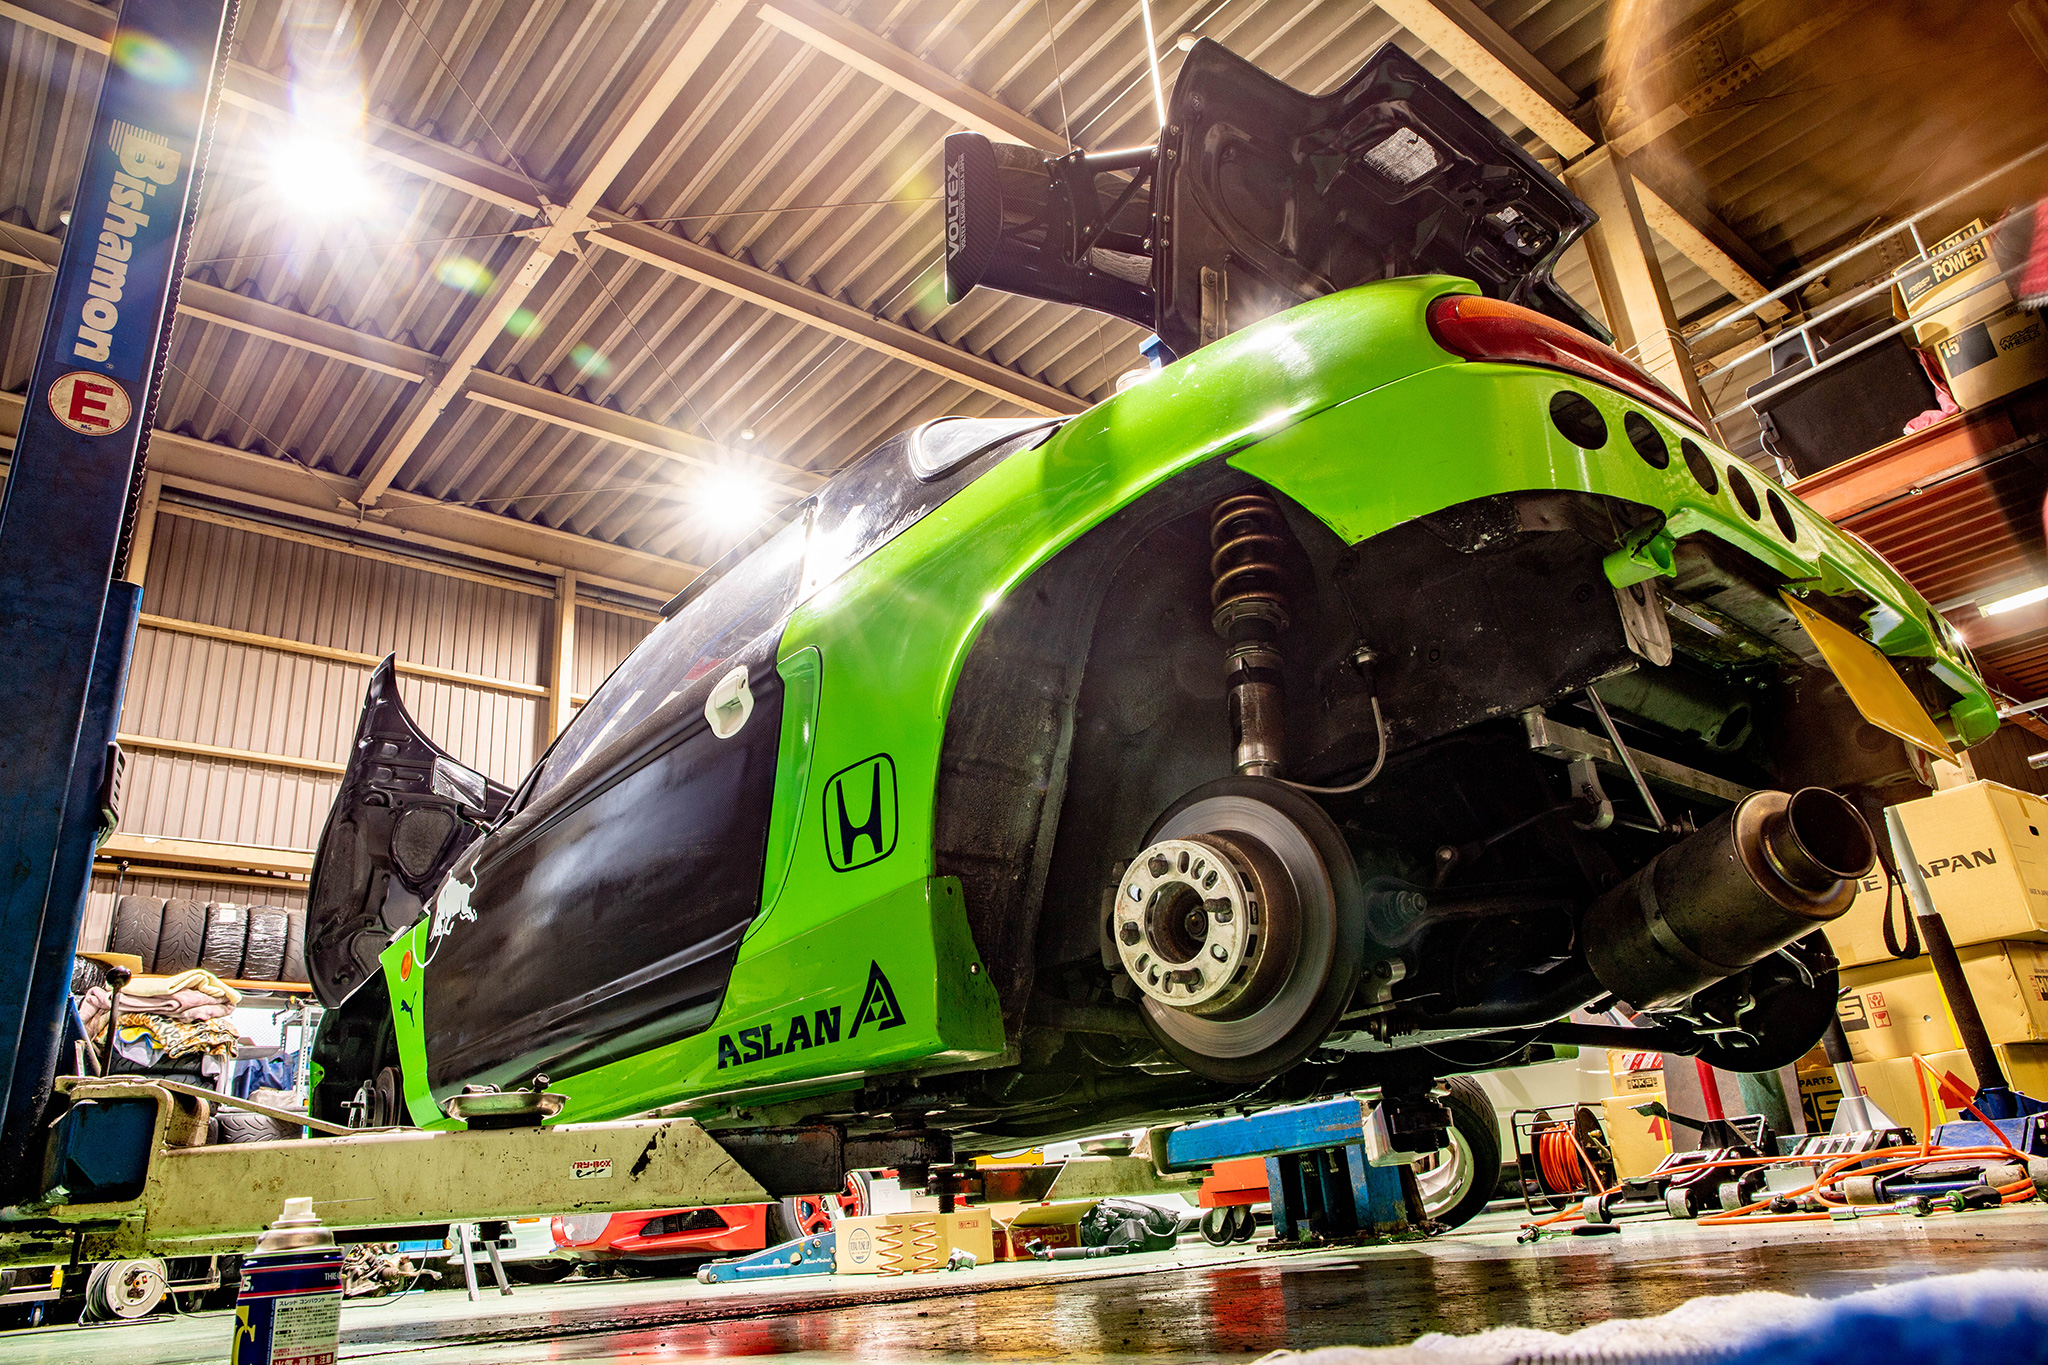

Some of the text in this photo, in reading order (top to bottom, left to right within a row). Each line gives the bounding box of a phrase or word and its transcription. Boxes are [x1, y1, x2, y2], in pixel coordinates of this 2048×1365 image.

[947, 161, 959, 261] VOLTEX
[73, 119, 182, 363] Bishamon
[1932, 244, 1985, 283] POWER
[2001, 330, 2041, 351] WHEELS
[68, 379, 114, 429] E
[718, 1005, 841, 1069] ASLAN
[1631, 1077, 1654, 1090] HKS
[1800, 1075, 1834, 1087] PARTS
